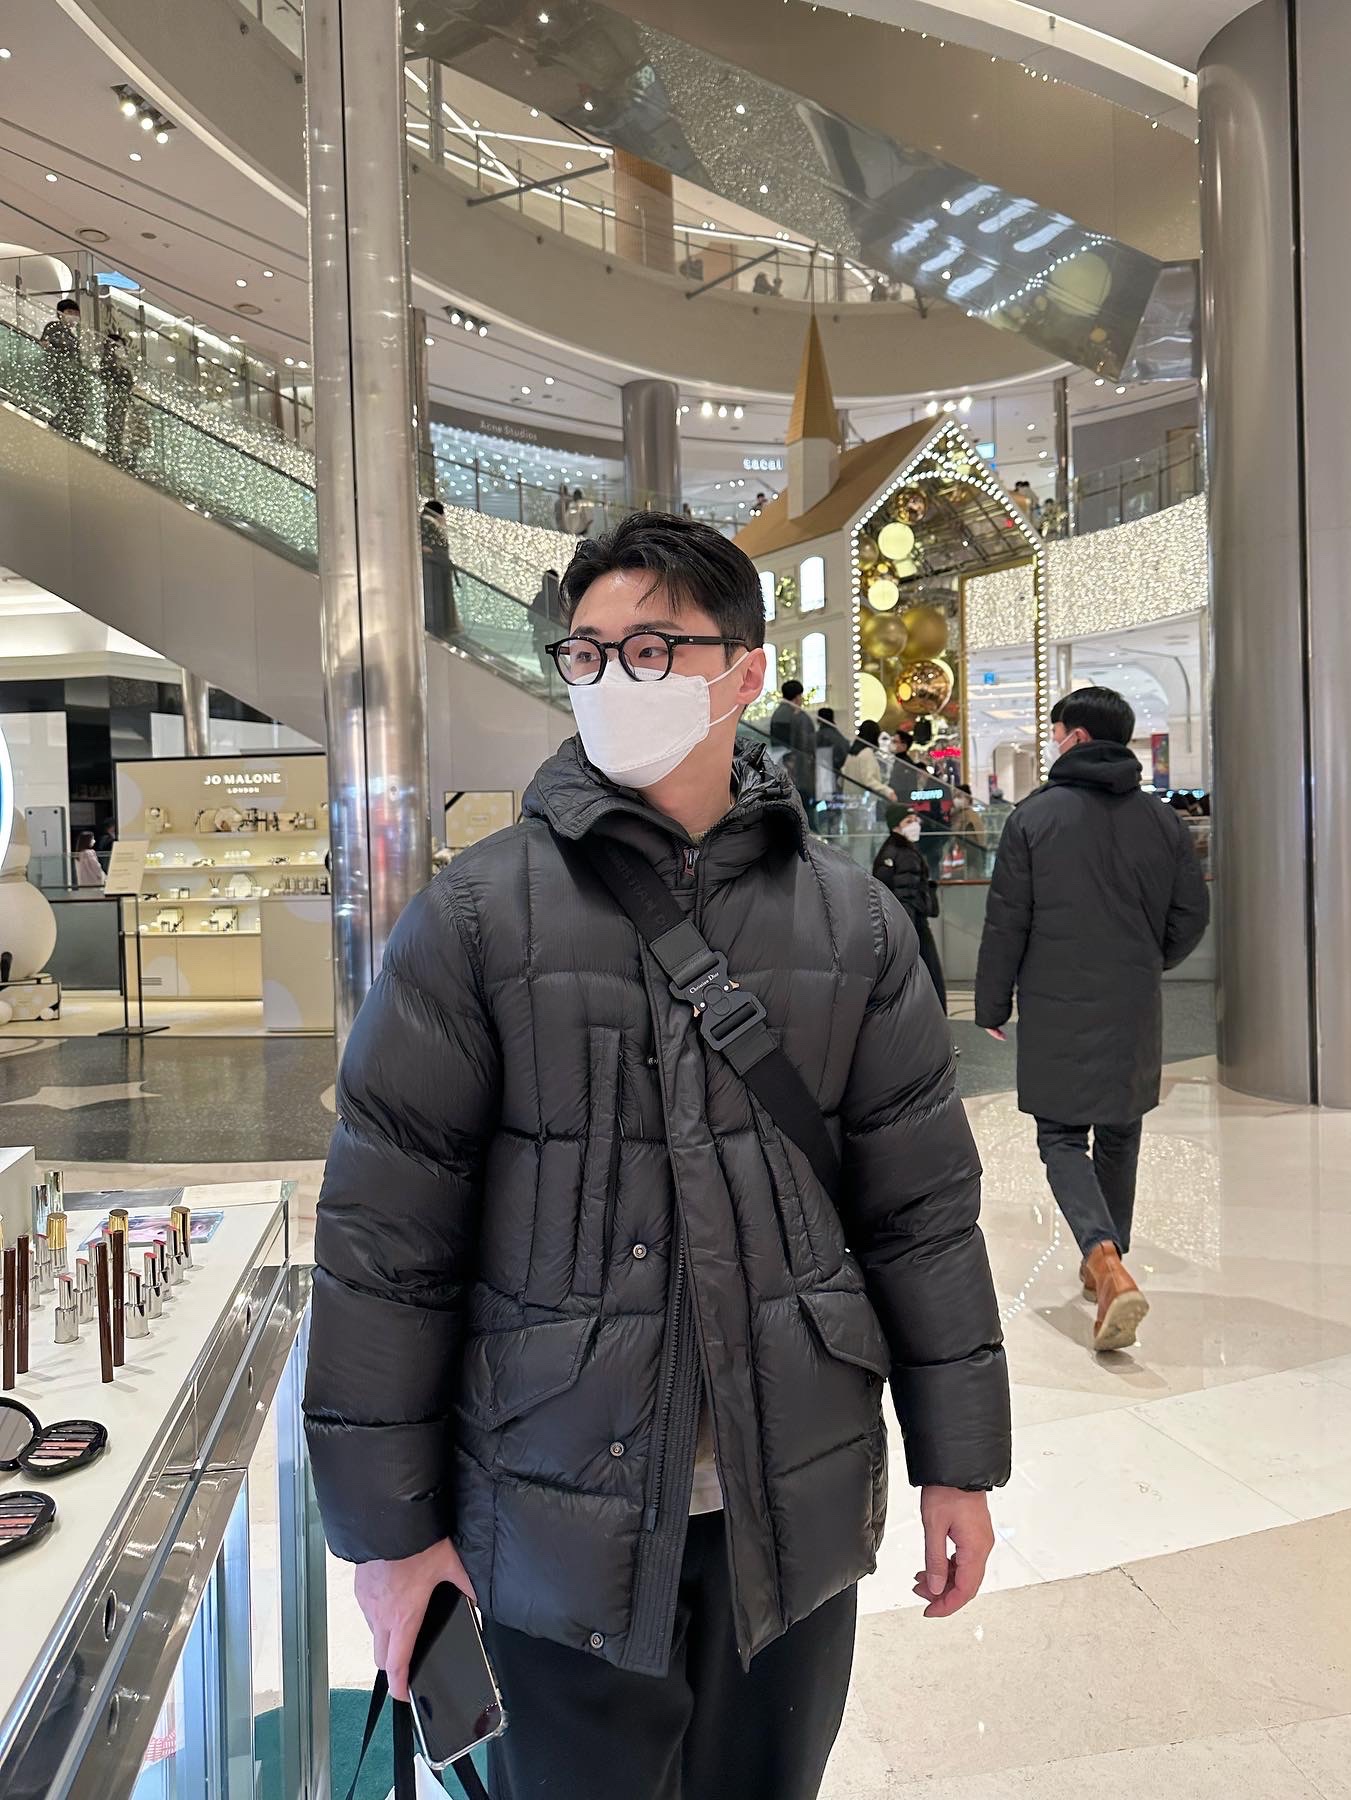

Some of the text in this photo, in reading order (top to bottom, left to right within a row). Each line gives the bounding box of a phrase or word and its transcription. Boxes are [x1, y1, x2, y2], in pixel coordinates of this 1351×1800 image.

[480, 420, 538, 441] Acne Studios
[204, 773, 281, 785] JO MALONE
[689, 979, 709, 994] Christian
